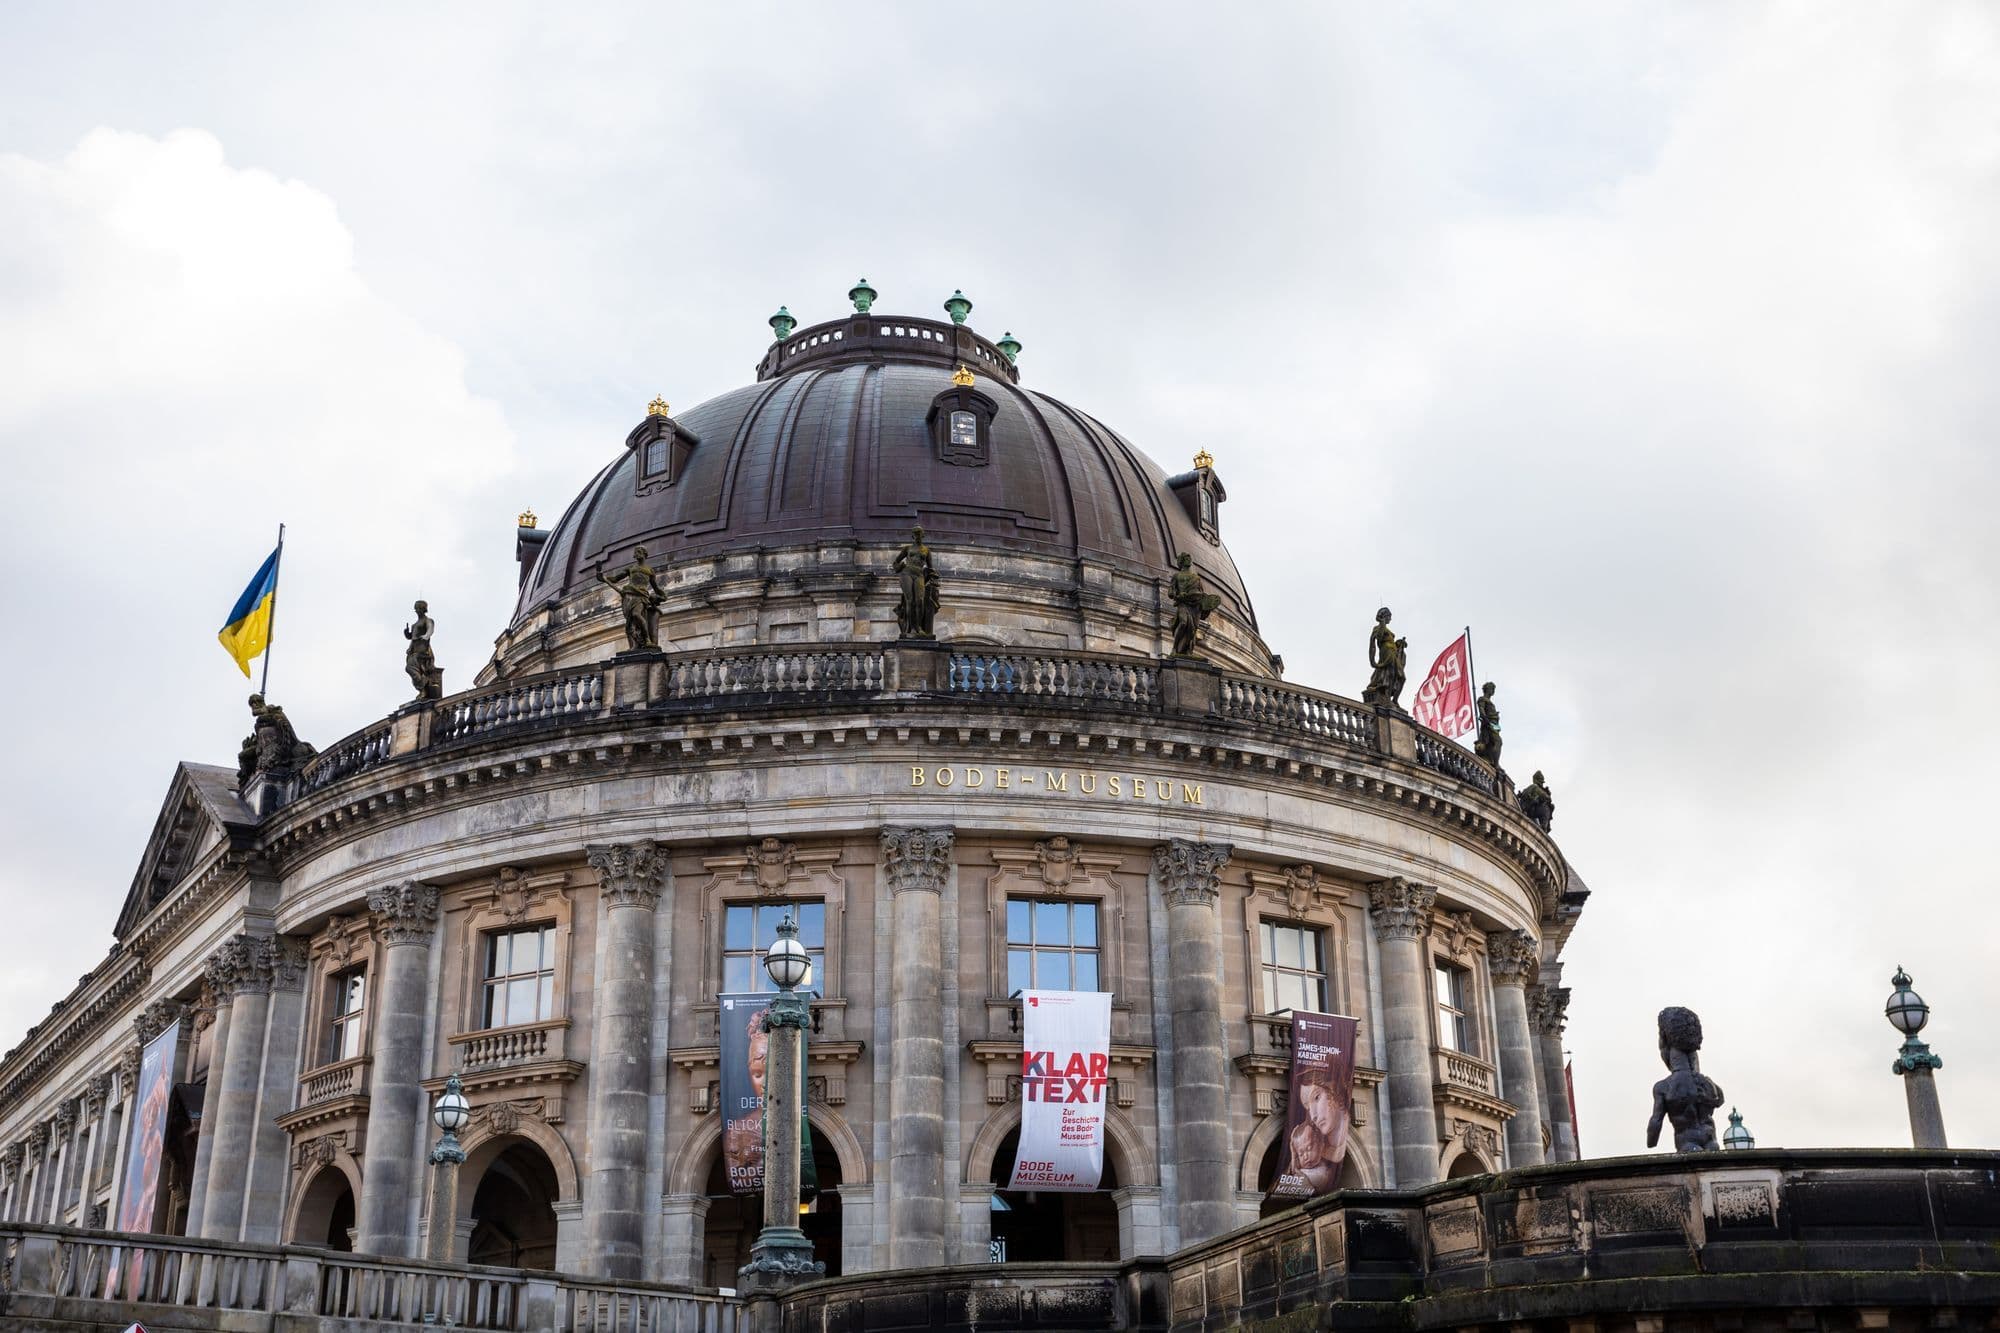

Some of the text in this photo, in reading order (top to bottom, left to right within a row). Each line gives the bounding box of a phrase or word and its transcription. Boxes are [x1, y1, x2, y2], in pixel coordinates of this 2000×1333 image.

[911, 766, 1203, 804] BODE-MUSEUM
[1023, 1051, 1107, 1077] KLAR
[1023, 1076, 1107, 1104] TEXT
[740, 1096, 763, 1109] DER
[1062, 1108, 1075, 1116] Zur
[727, 1119, 763, 1131] BLICK
[1019, 1160, 1055, 1171] BODE
[729, 1166, 764, 1177] BODE
[1016, 1172, 1075, 1182] MUSEUM
[731, 1177, 765, 1188] MUS
[1280, 1174, 1305, 1185] BODE
[1275, 1185, 1316, 1196] MUSEUM
